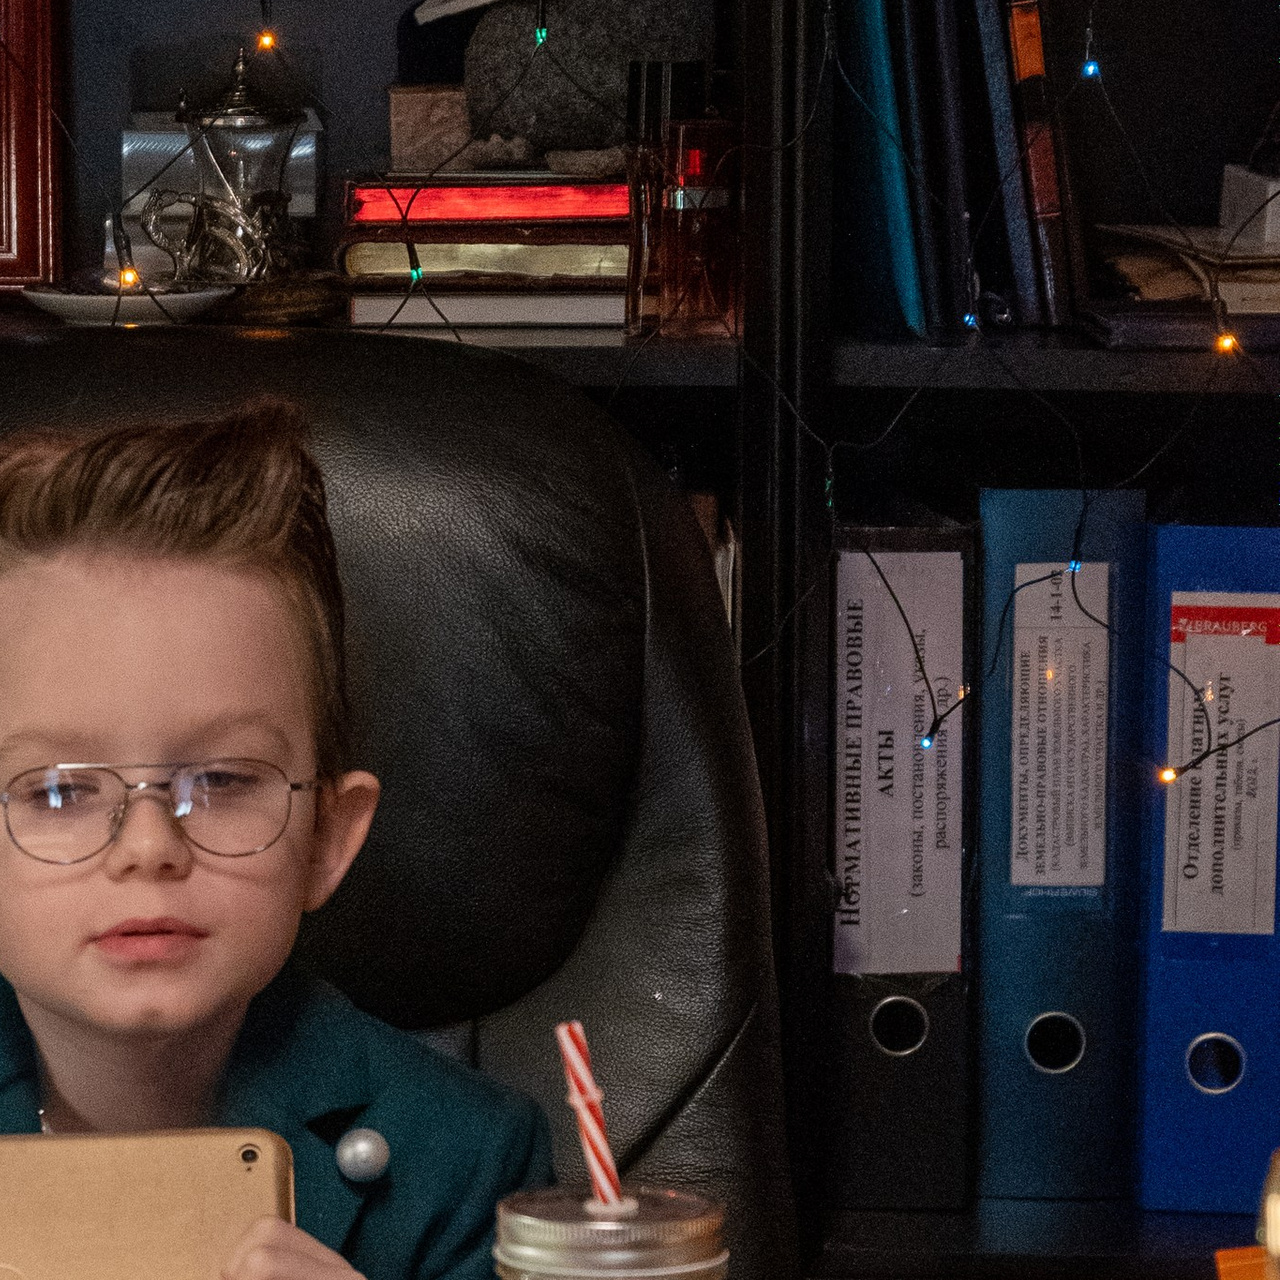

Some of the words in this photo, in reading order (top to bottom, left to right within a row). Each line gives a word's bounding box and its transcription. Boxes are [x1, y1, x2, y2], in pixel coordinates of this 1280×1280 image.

[844, 597, 864, 729] ПРАВОВЫЕ
[1018, 650, 1032, 765] ОПРЕДЕЛЯЮЩИЕ
[1215, 670, 1234, 725] услуг
[876, 728, 895, 797] АКТЫ
[933, 728, 952, 848] распоряжения
[1015, 768, 1030, 861] ДОКУМЕНТЫ,
[1035, 726, 1048, 875] ЗЕМЕЛЬНО-ПРАВОВЫЕ
[1208, 730, 1229, 895] дополнительных
[839, 736, 863, 926] НОРМАТИВНЫЕ
[909, 823, 928, 897] (законы,
[1182, 775, 1202, 880] Отделение
